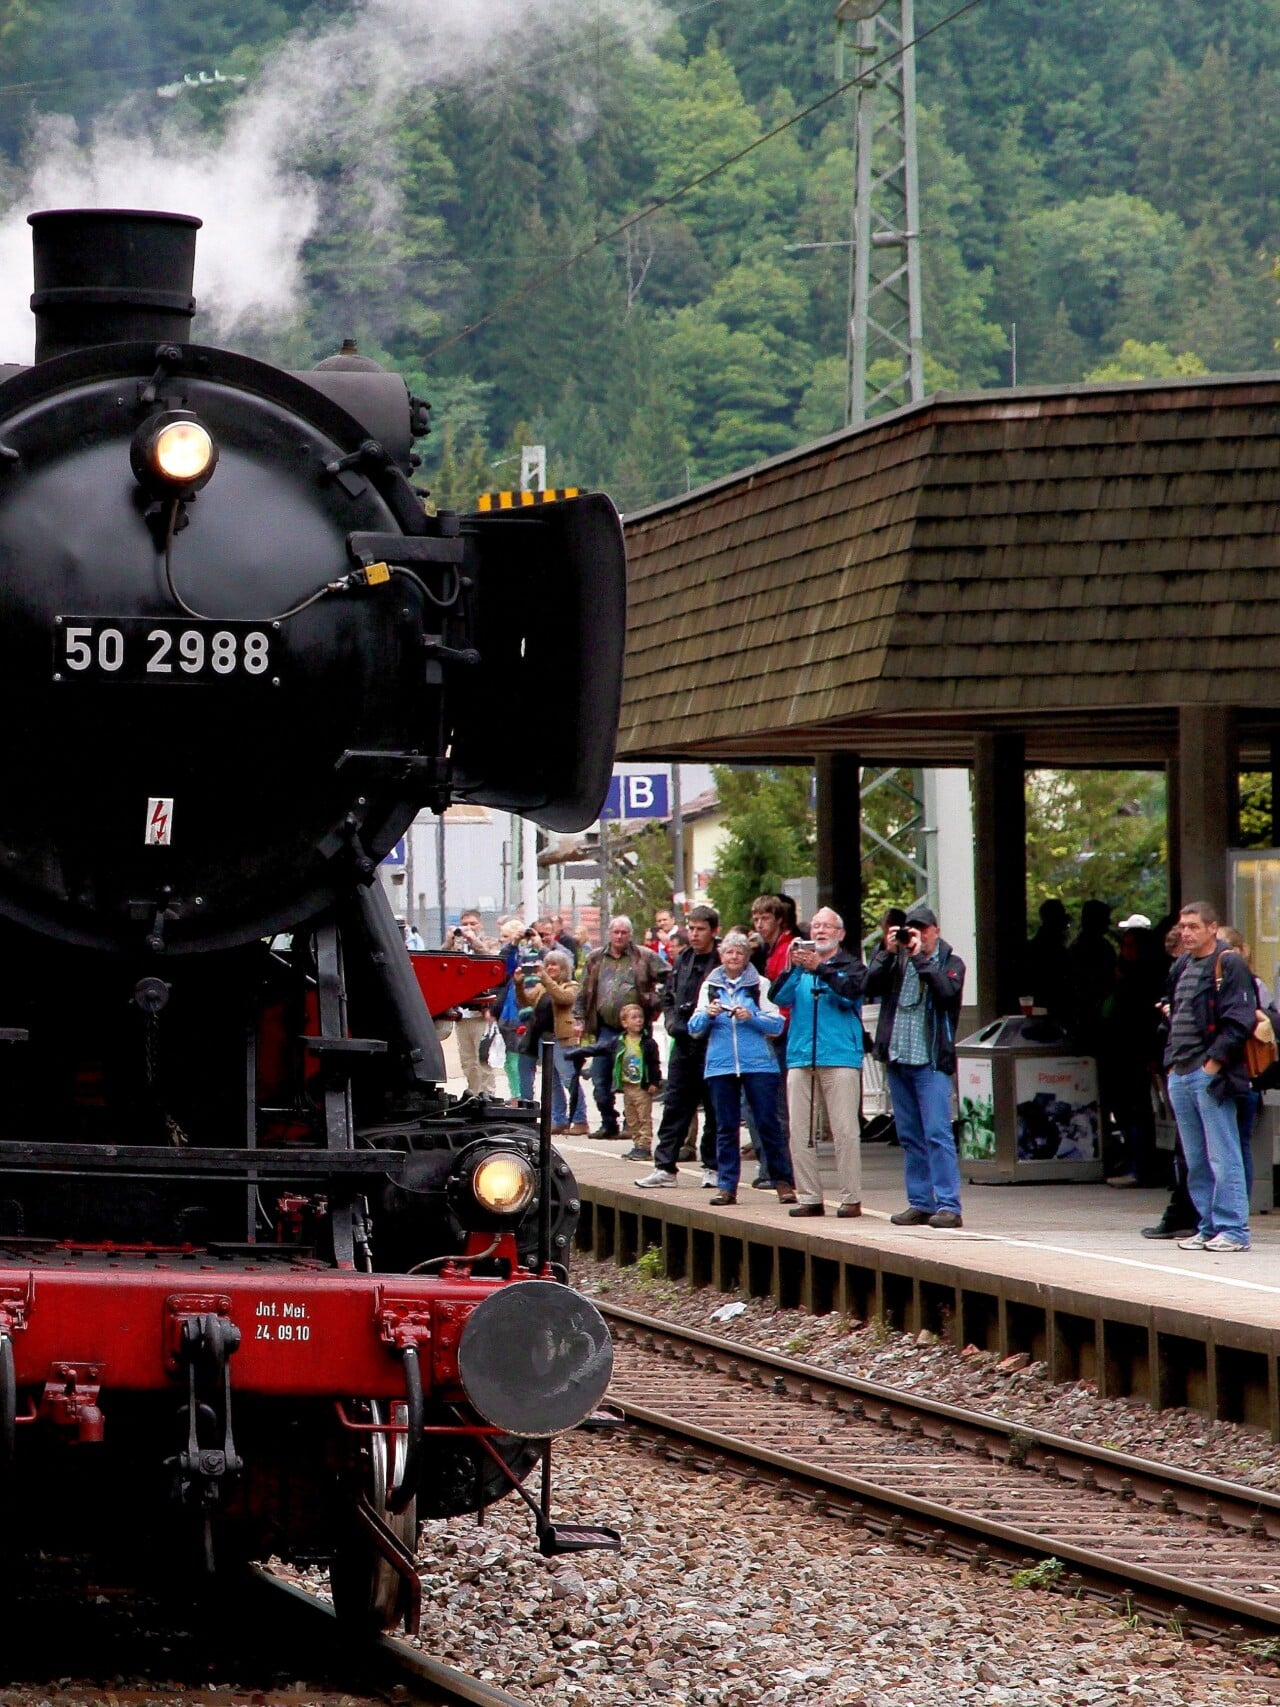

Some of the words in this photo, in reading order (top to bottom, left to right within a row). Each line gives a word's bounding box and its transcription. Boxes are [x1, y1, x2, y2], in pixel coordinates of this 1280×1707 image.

[66, 627, 124, 672] 50
[146, 629, 269, 674] 2988
[629, 776, 655, 809] B
[283, 1302, 310, 1319] Mei.
